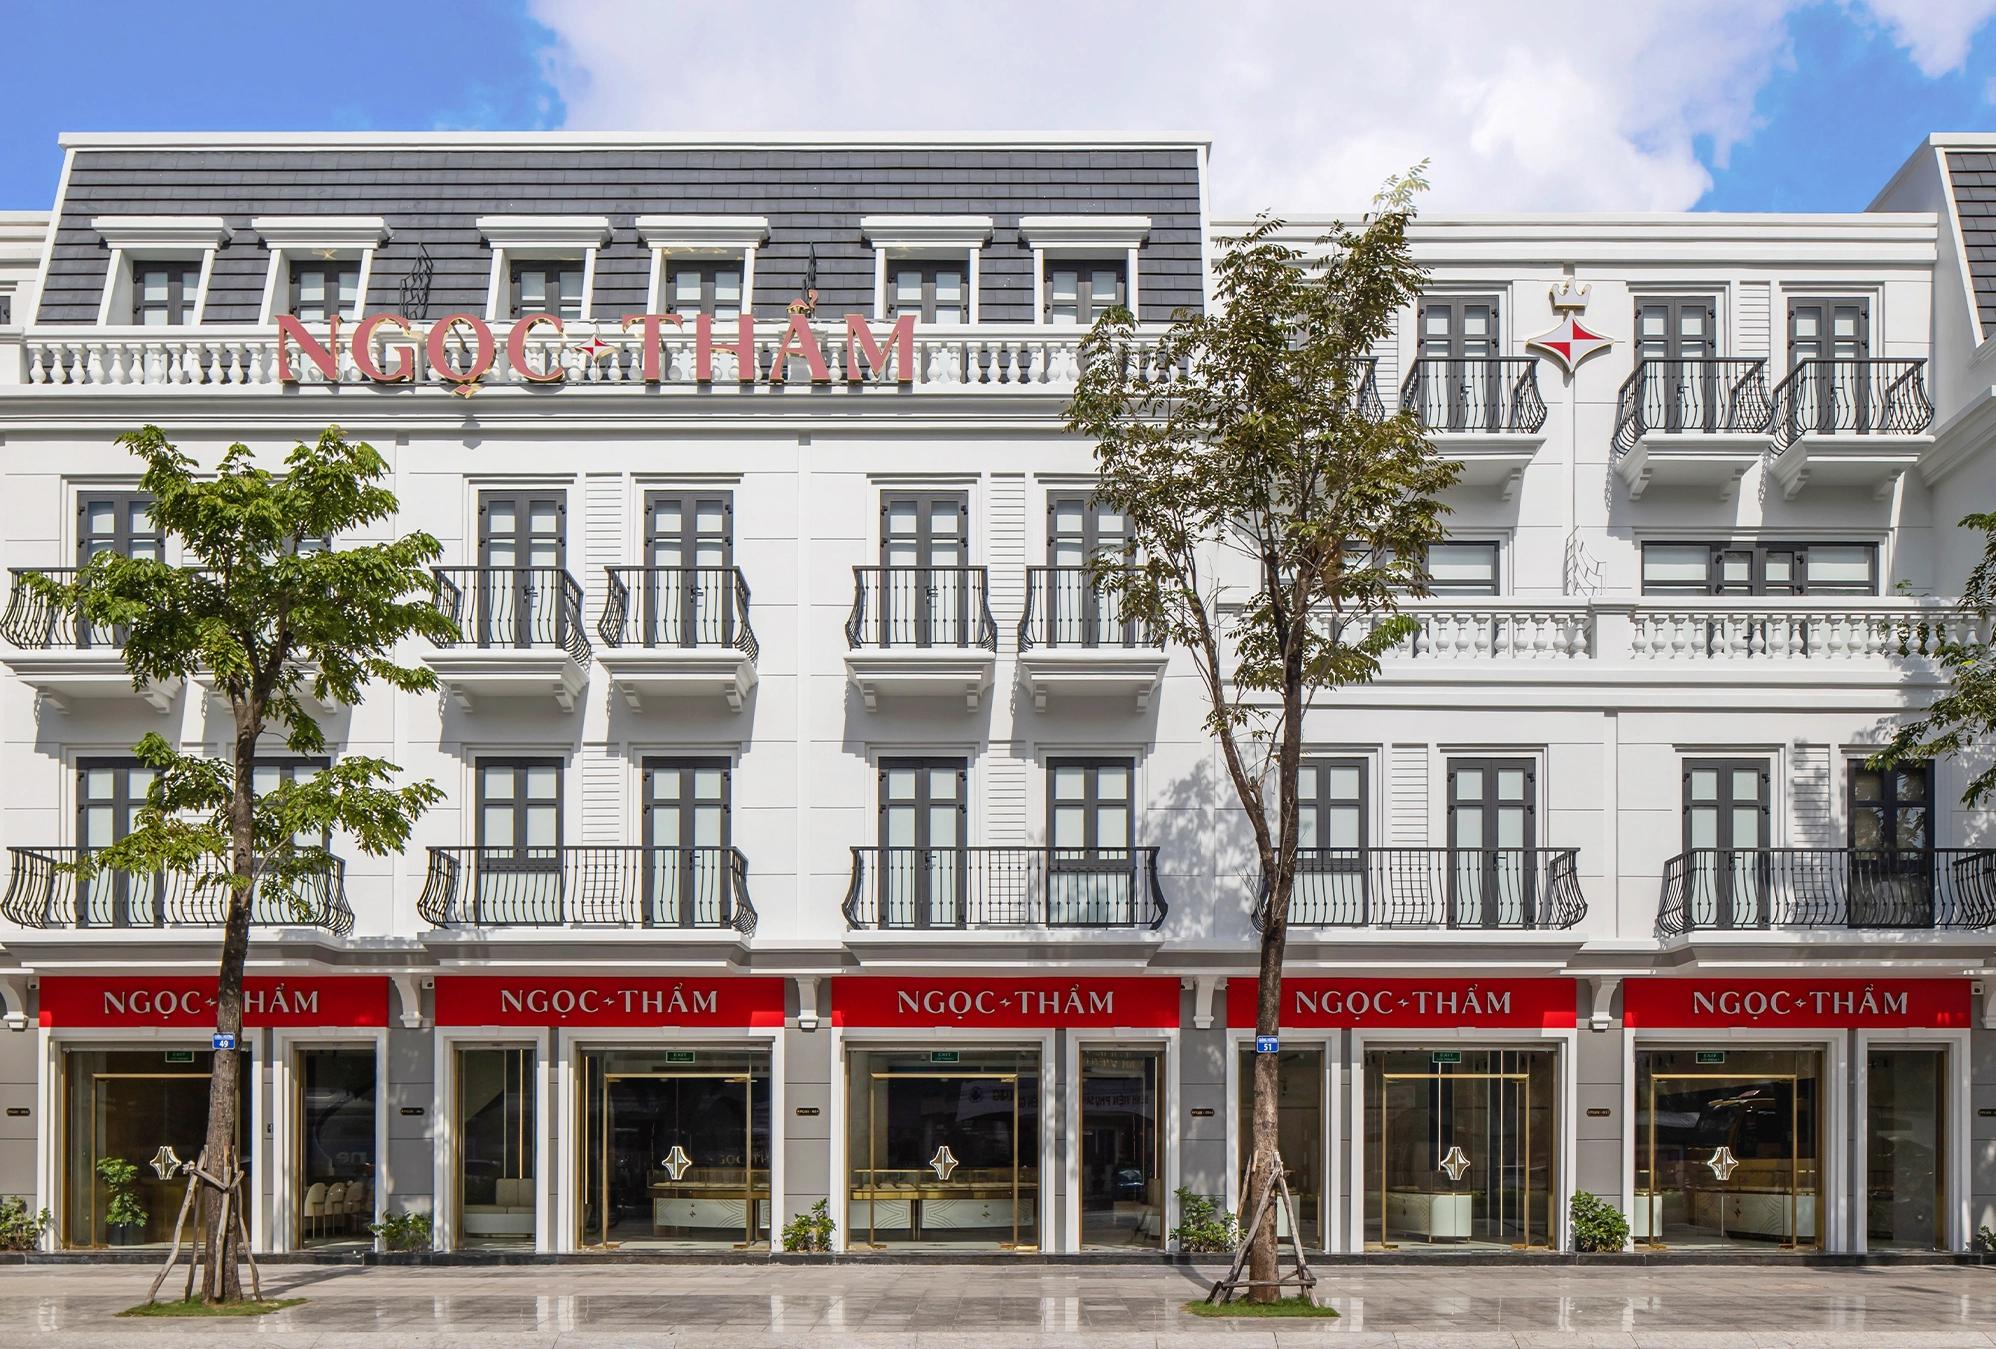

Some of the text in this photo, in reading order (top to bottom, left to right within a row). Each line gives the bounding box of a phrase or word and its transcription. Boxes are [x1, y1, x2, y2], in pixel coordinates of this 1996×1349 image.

[274, 289, 917, 399] NGỌC THẨM
[103, 982, 318, 1020] NGỌC HẨM
[501, 982, 718, 1019] NGỌC THẨM
[897, 983, 1114, 1020] NGỌC THẨM
[1295, 983, 1511, 1021] NGỌC THẨM
[1693, 983, 1908, 1020] NGỌC THẨM
[219, 1040, 229, 1048] 49
[1263, 1043, 1272, 1051] 51
